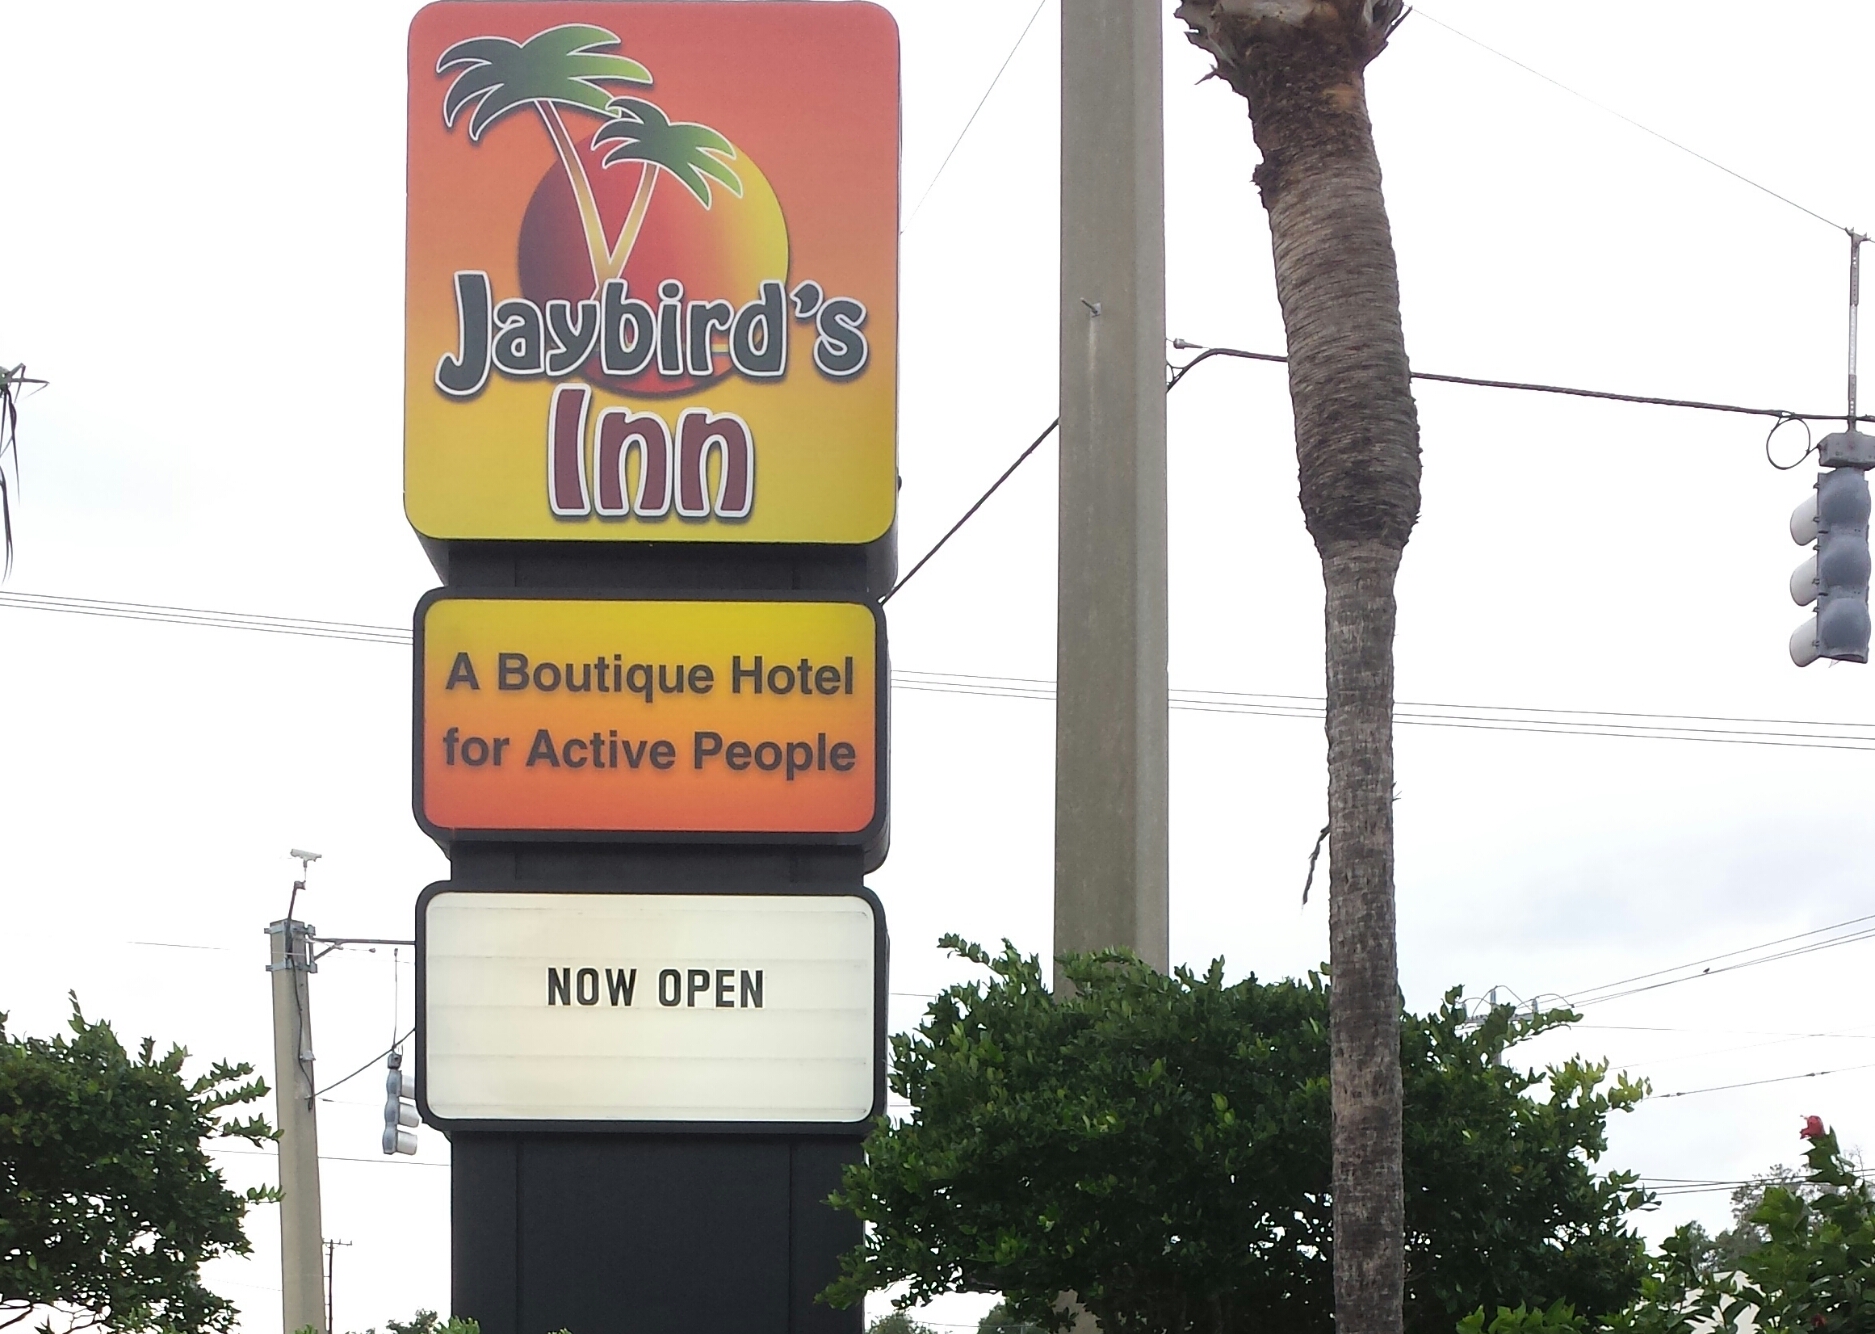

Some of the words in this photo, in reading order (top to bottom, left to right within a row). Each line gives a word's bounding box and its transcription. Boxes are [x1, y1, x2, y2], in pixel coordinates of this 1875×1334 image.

[435, 270, 869, 397] Jaybird's
[547, 383, 753, 517] Inn
[446, 652, 480, 690] A
[498, 652, 714, 703] Boutique
[732, 655, 854, 696] Hotel
[443, 727, 510, 767] for
[526, 729, 676, 770] Active
[694, 731, 856, 781] People
[547, 967, 637, 1007] NOW
[658, 968, 764, 1009] OPEN
